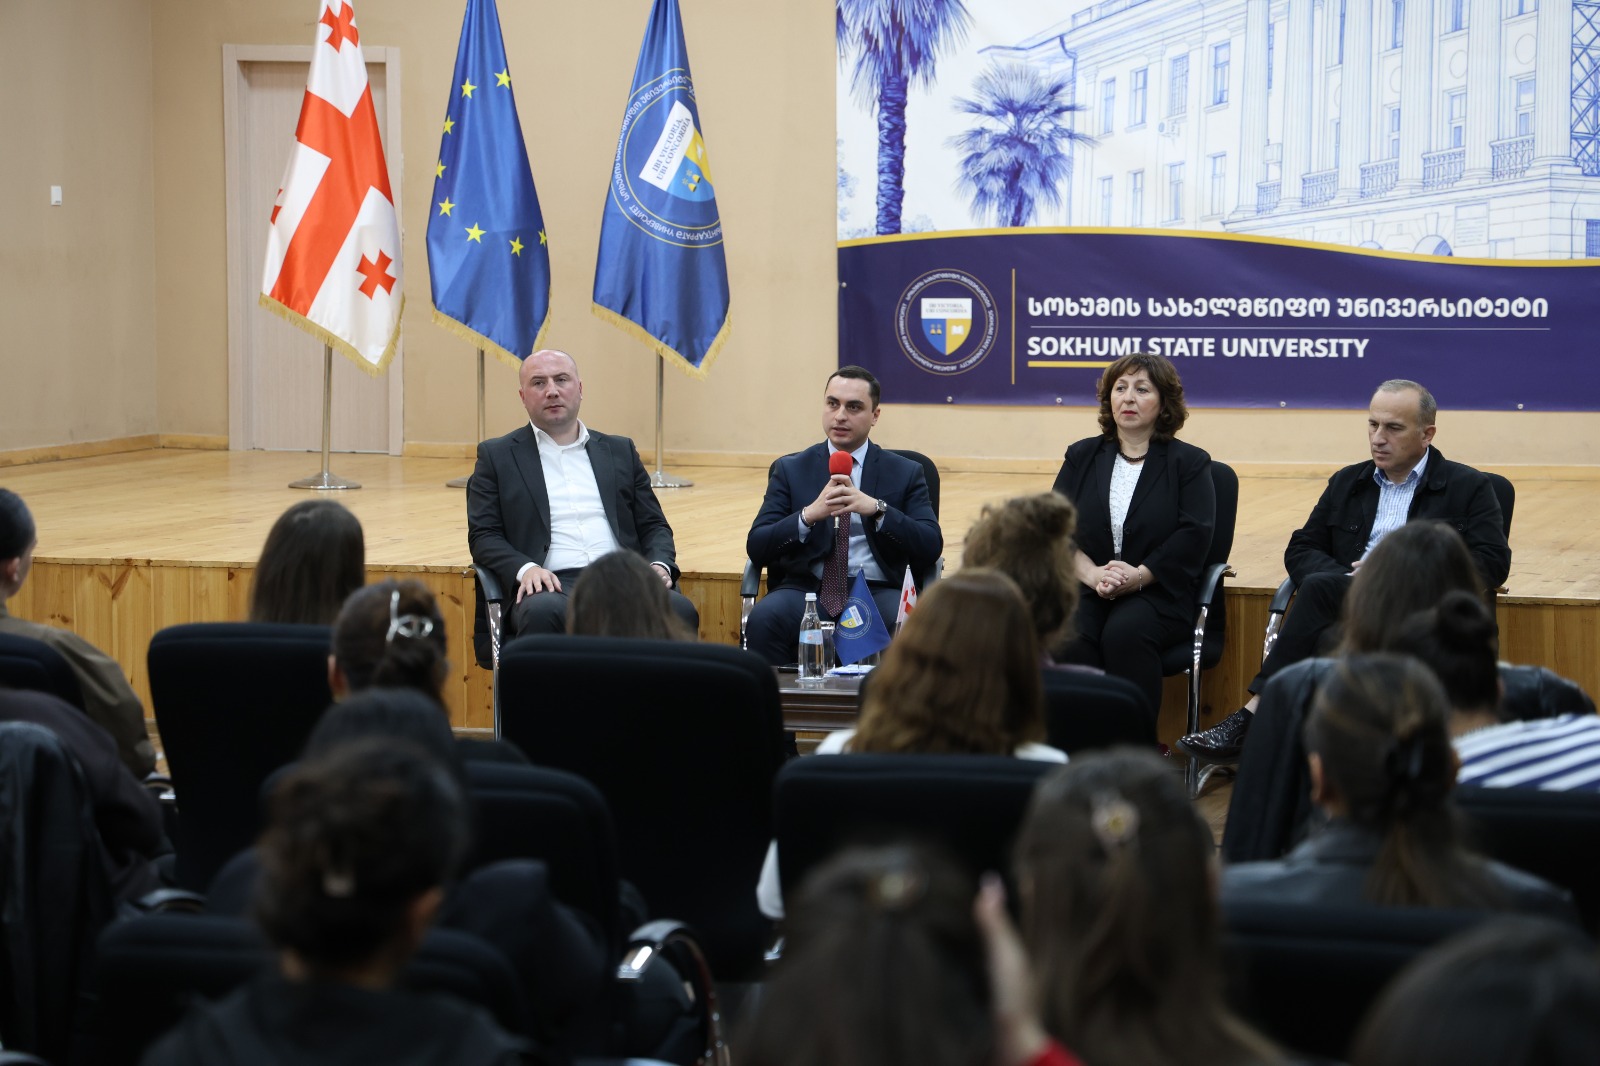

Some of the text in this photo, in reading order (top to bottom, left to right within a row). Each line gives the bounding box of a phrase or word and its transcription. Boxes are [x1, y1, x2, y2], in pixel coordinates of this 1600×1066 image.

[652, 117, 684, 172] IBI VICTORIA,
[656, 117, 691, 181] UBI CONCORDIA
[1028, 296, 1548, 318] სოხუმის სახელმწიფო უნივერსიტეტი
[1027, 336, 1370, 358] SOKHUMI STATE UNIVERSITY
